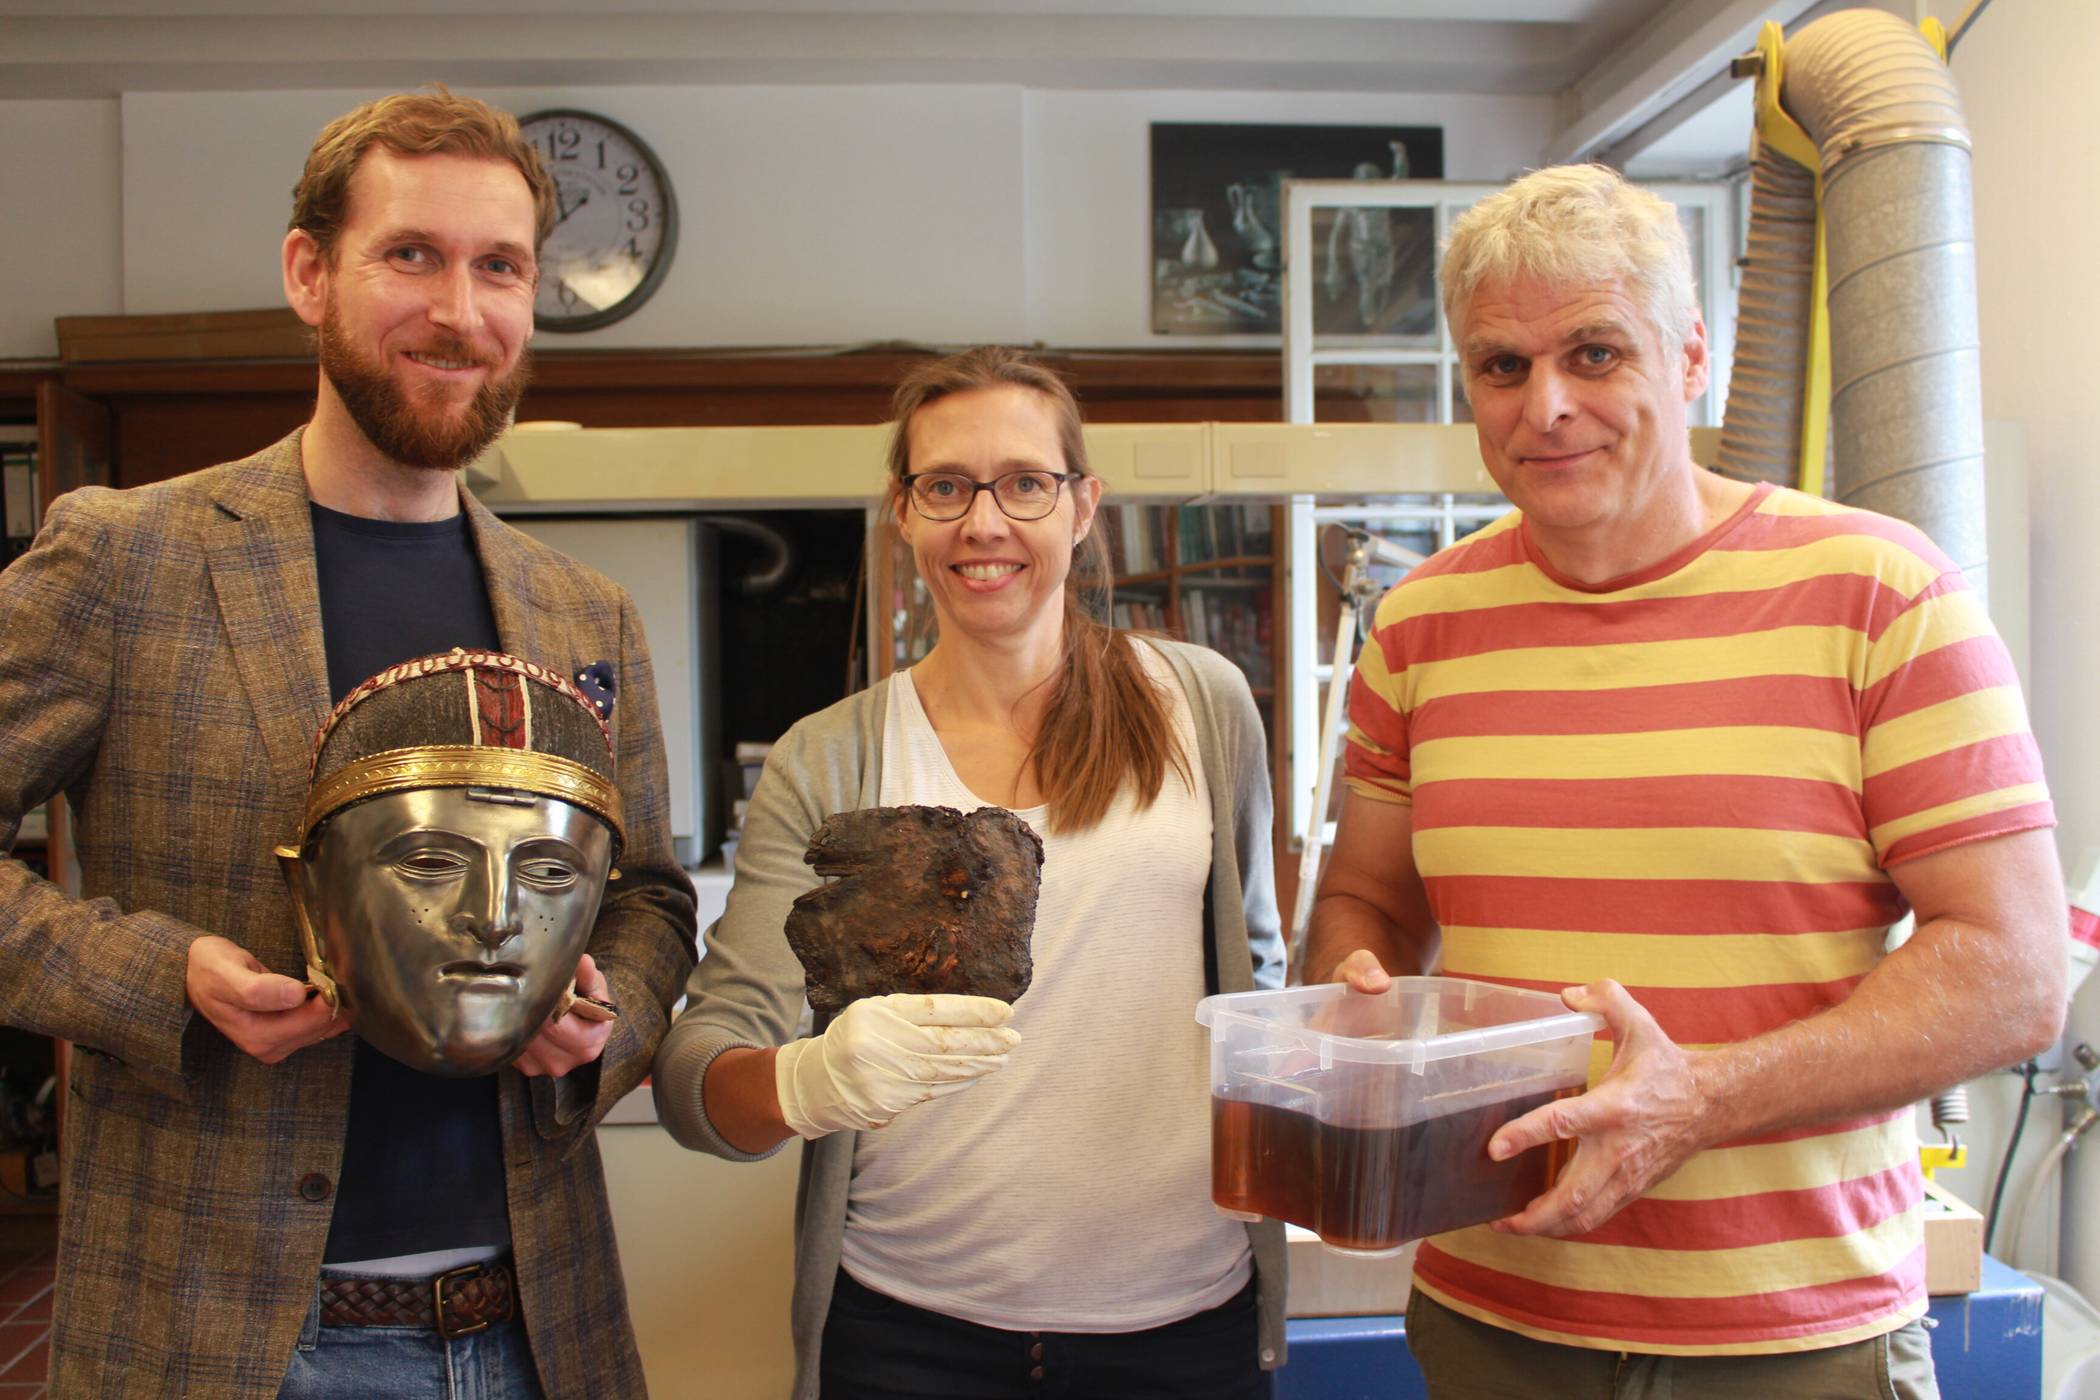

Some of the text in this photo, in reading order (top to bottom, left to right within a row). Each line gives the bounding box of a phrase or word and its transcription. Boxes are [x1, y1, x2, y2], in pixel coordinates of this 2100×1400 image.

[548, 128, 582, 161] 12
[596, 140, 606, 170] 1
[616, 164, 640, 196] 2
[626, 199, 649, 232] 3
